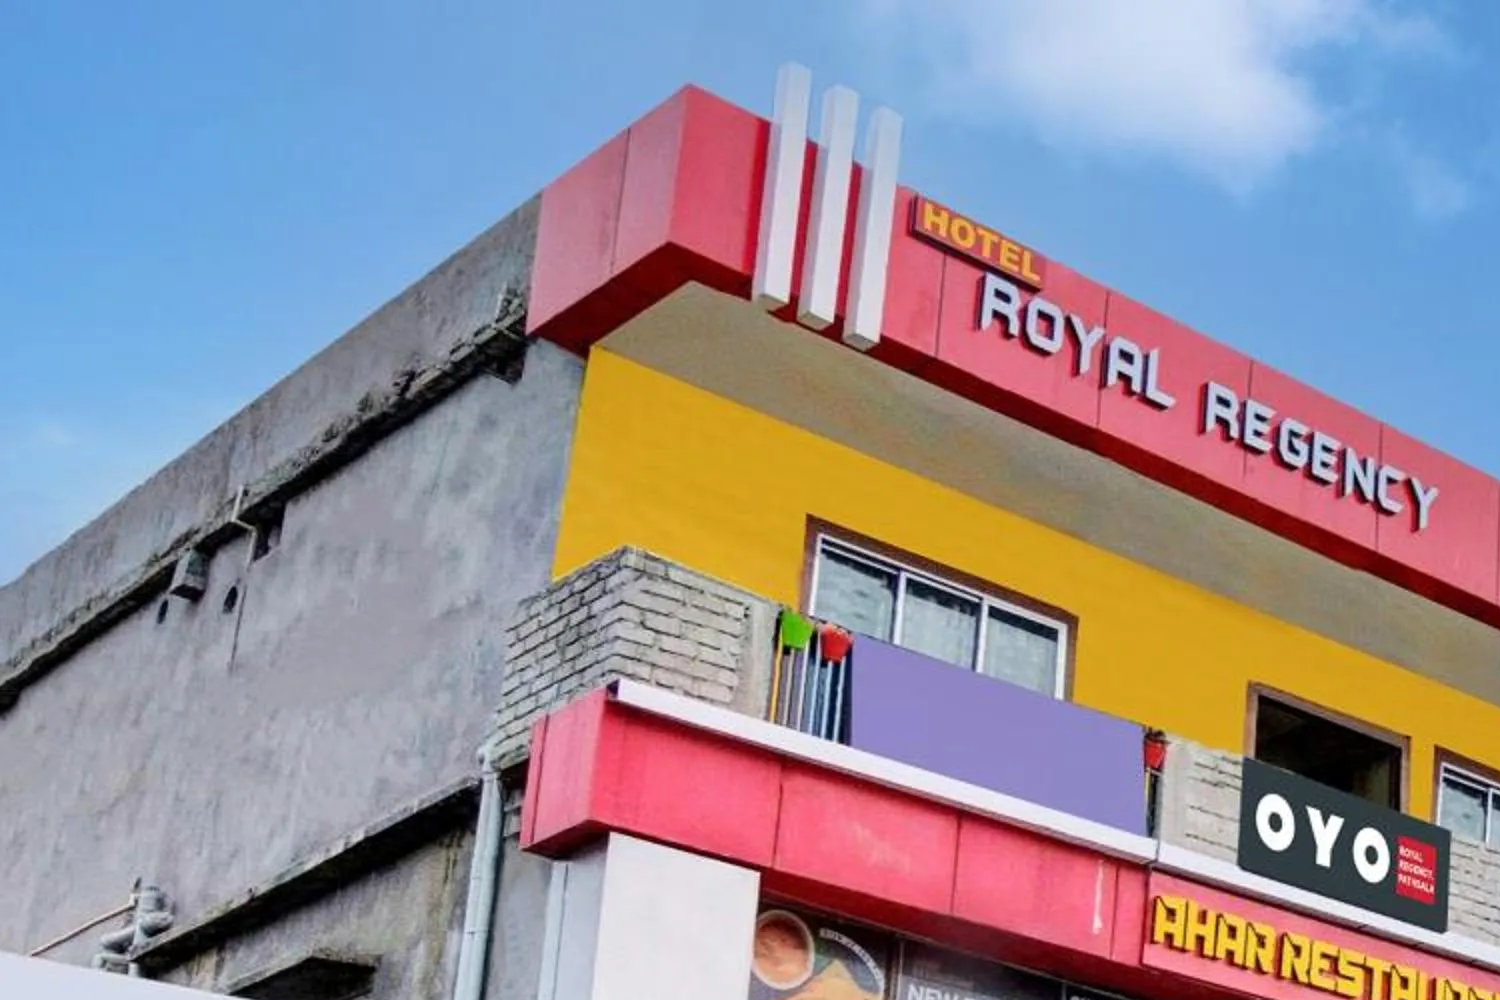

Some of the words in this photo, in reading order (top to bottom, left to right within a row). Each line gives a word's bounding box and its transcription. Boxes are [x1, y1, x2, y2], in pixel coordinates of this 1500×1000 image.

[922, 203, 1041, 283] HOTEL
[977, 271, 1176, 411] ROYAL
[1200, 380, 1439, 531] REGENCY
[1256, 793, 1390, 883] OYO
[1153, 896, 1275, 979] AHAR
